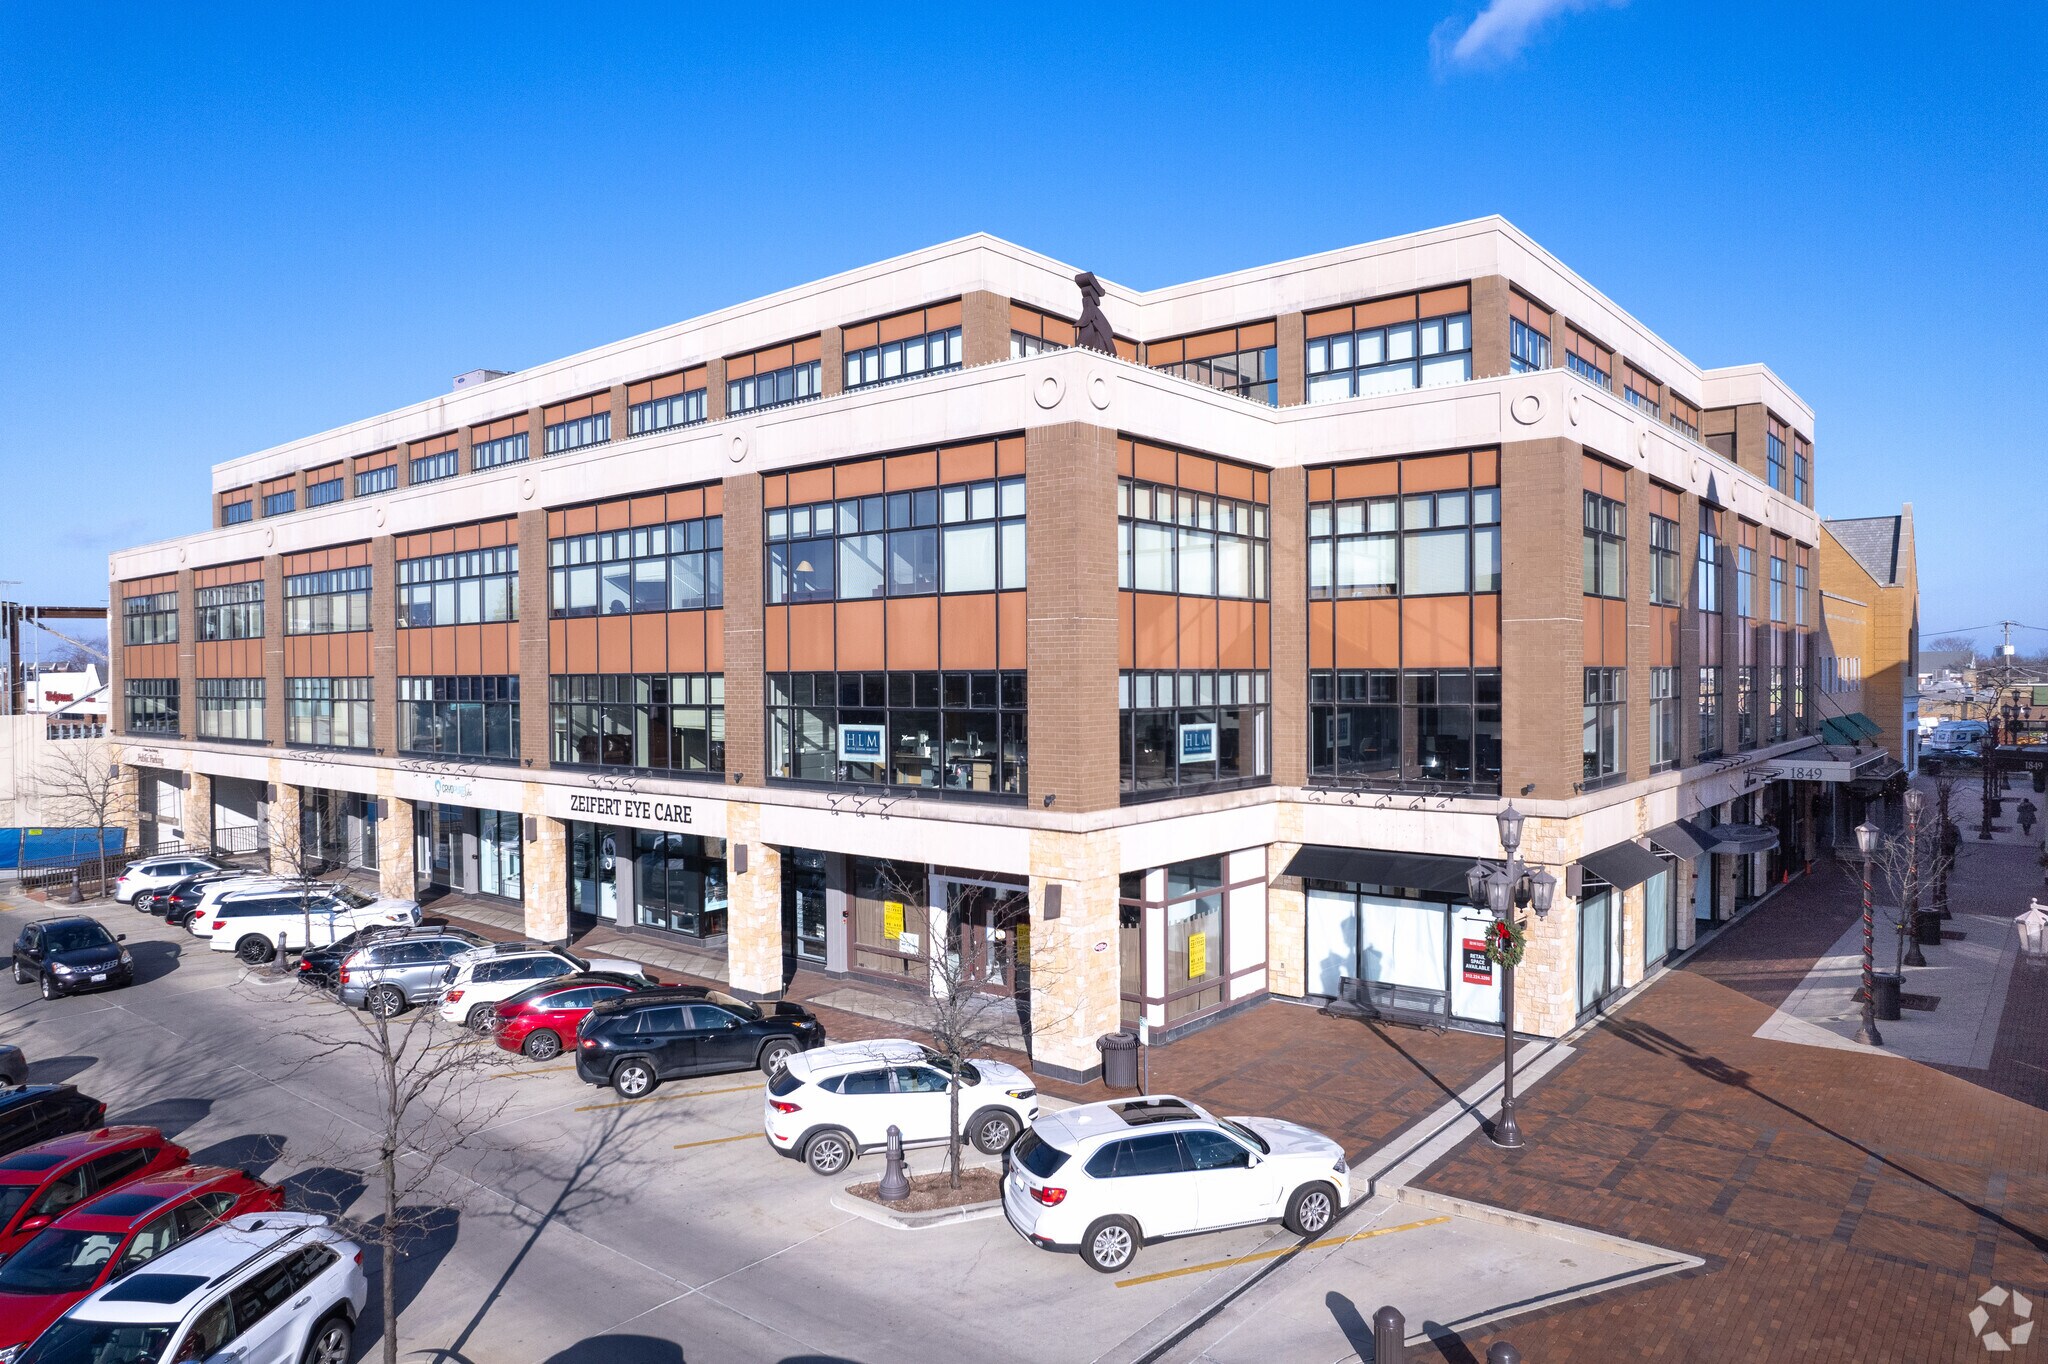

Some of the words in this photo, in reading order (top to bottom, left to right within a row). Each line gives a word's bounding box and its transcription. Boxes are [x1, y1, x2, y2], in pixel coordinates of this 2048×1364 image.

[846, 733, 878, 747] HLM
[1185, 733, 1210, 747] HLM
[1790, 767, 1822, 780] 1849
[571, 794, 621, 816] ZEIFERT
[624, 800, 651, 819] EYE
[654, 803, 692, 824] CARE
